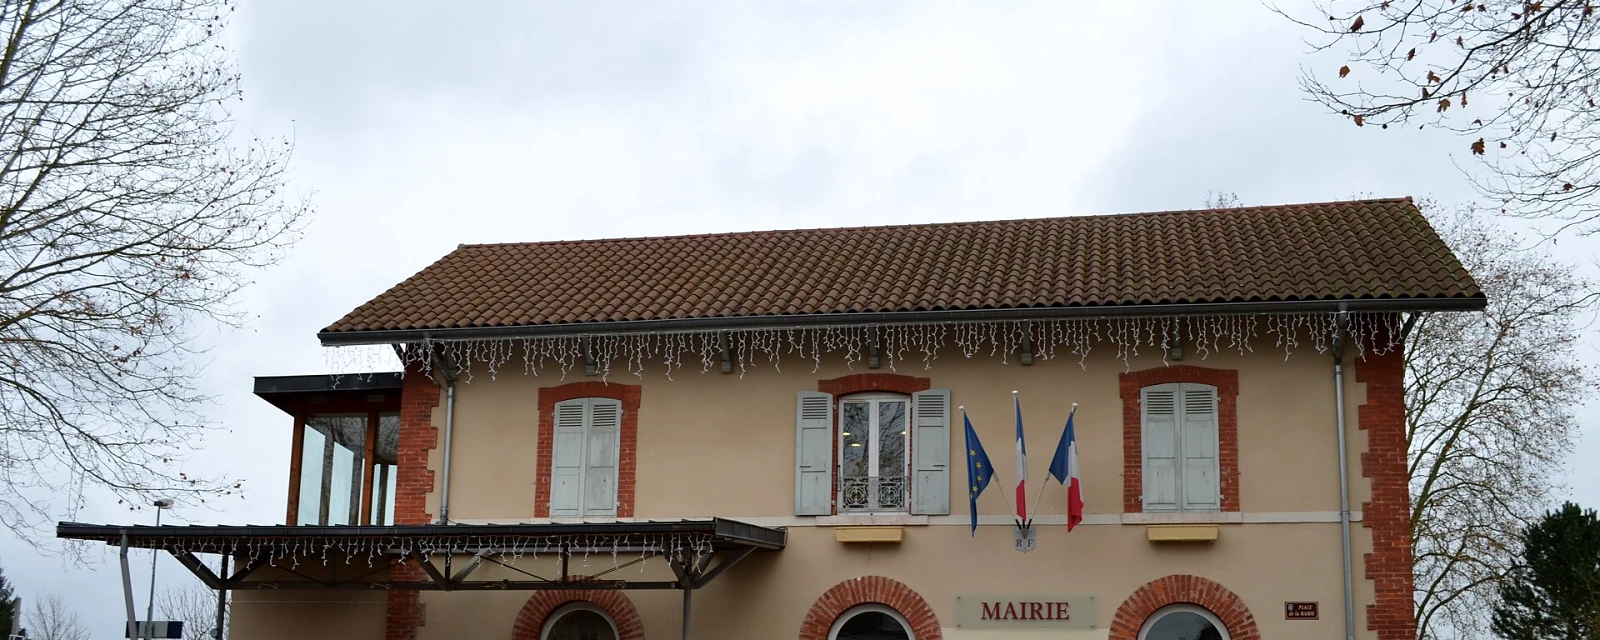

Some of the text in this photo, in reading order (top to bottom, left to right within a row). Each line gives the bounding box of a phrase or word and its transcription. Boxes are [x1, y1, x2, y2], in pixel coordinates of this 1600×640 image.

[1016, 539, 1033, 547] R F
[980, 601, 1070, 620] MAIRIE
